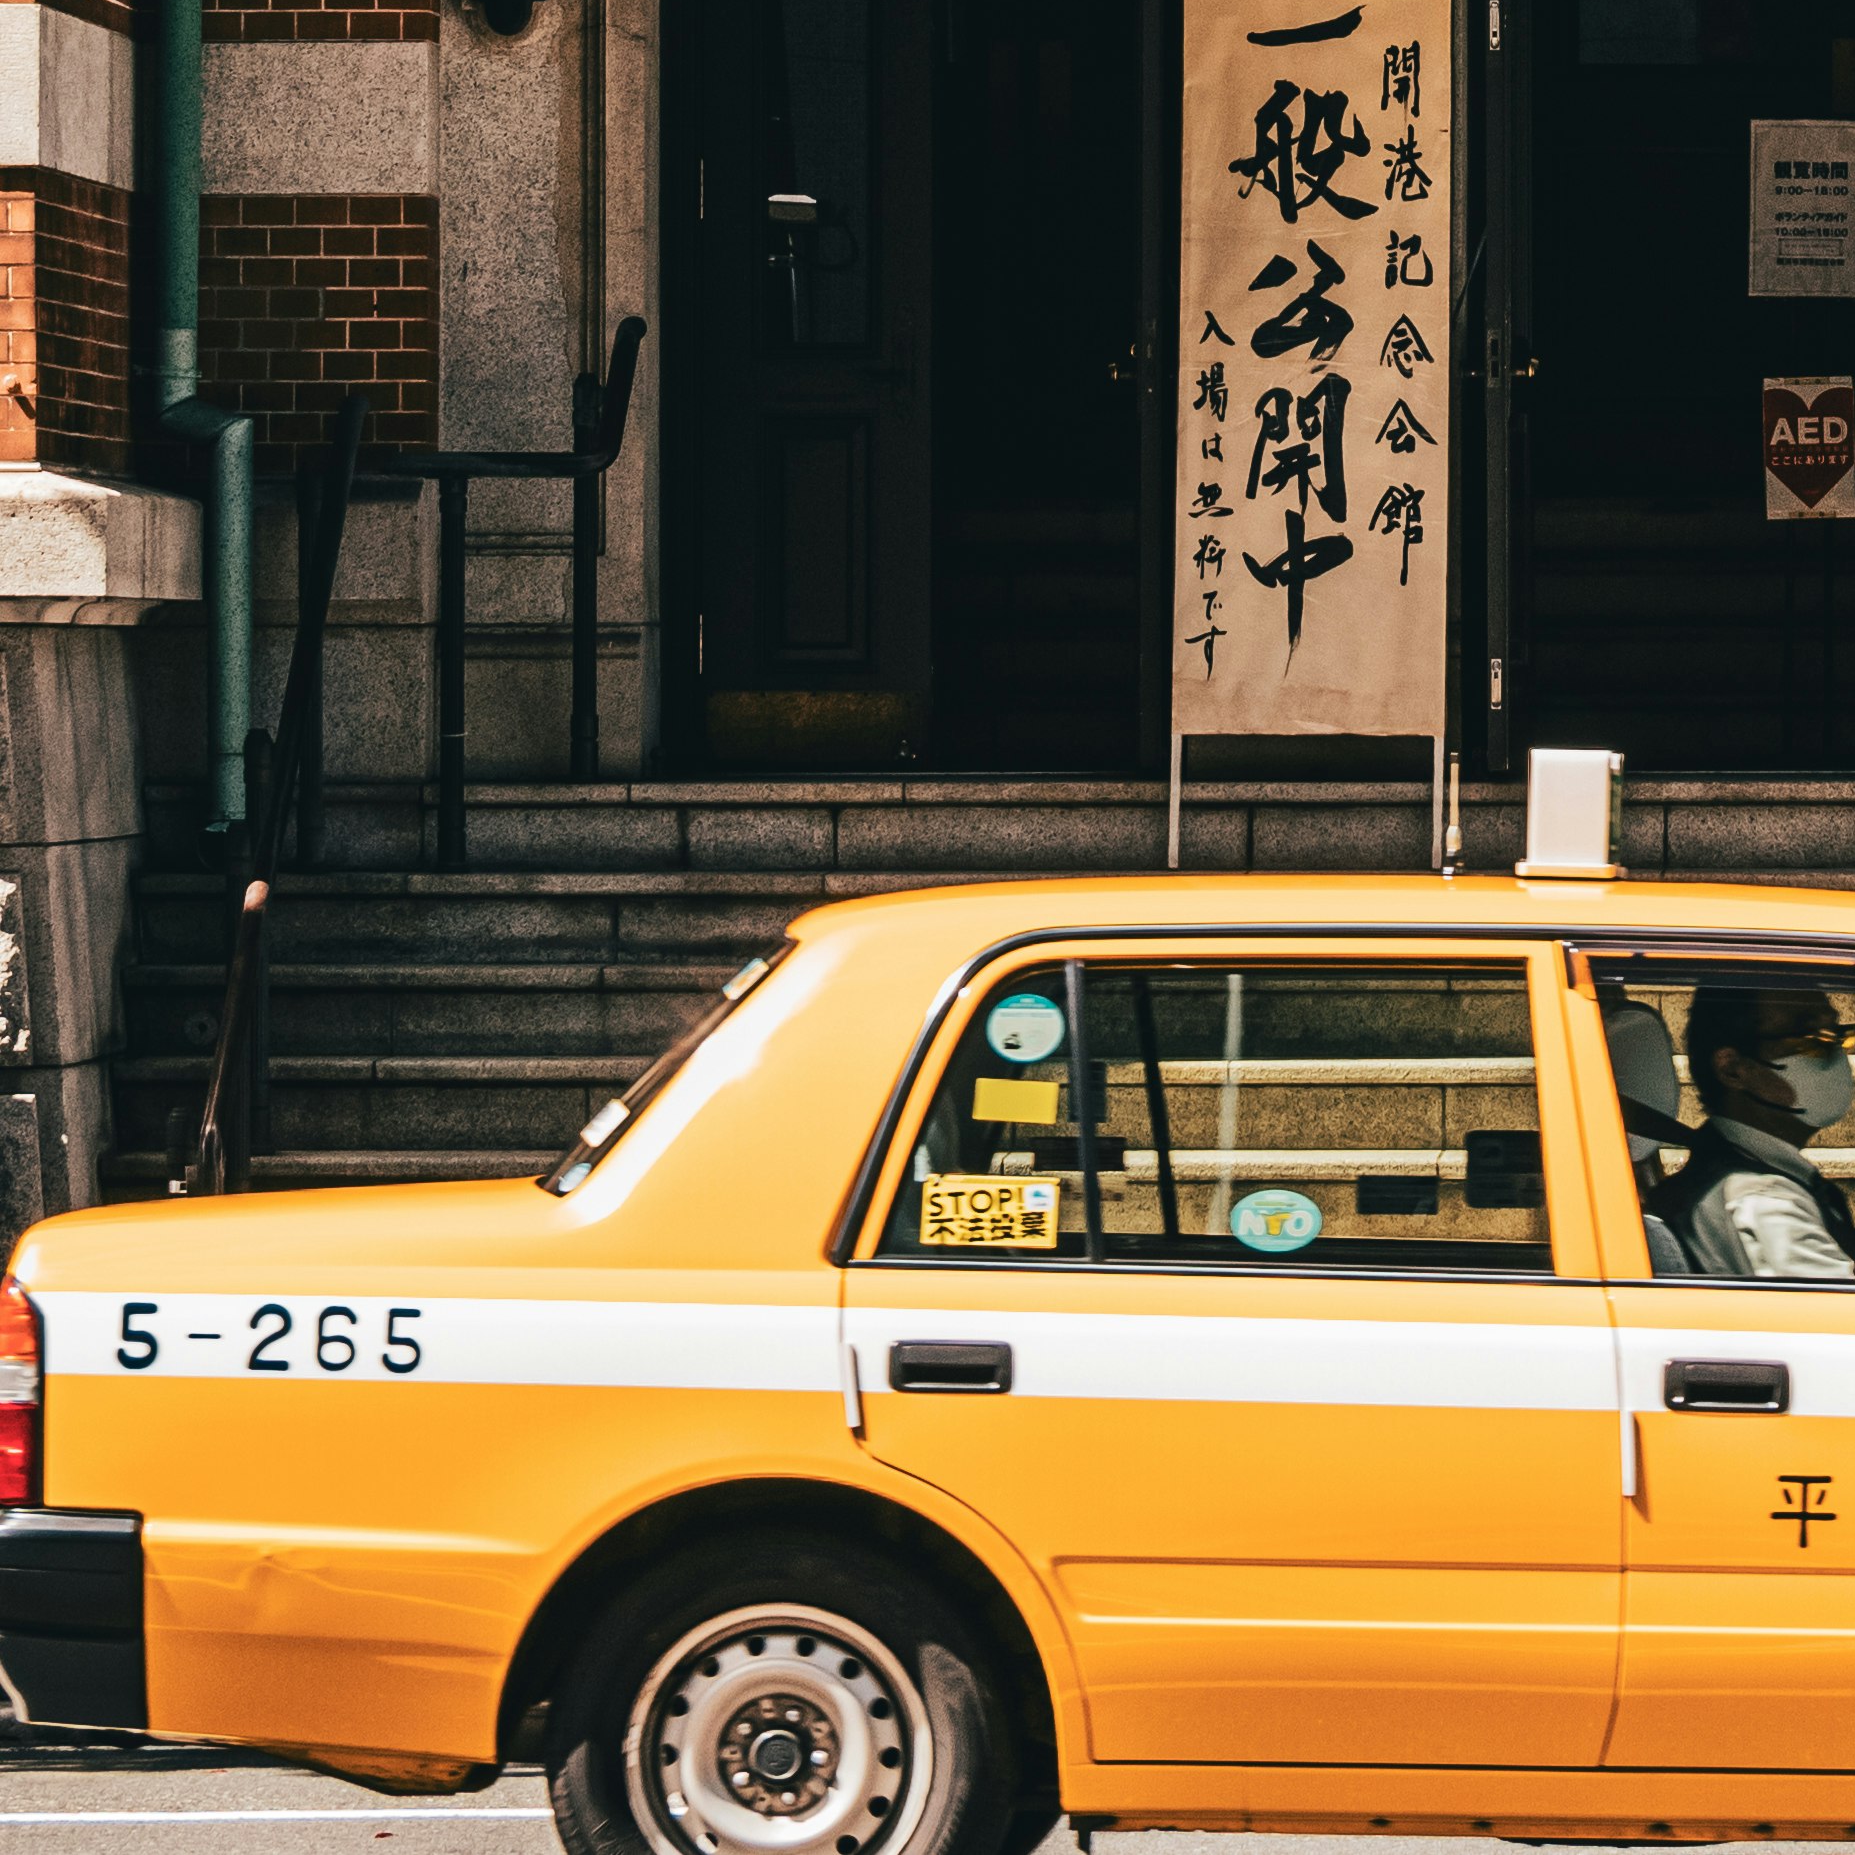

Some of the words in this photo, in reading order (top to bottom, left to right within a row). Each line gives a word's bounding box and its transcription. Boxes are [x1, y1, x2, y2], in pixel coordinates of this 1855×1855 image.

[1227, 4, 1380, 678] 一般公開中
[1368, 39, 1438, 586] 開港記念会館
[1184, 310, 1235, 681] 入場は無料です
[1769, 416, 1848, 446] AED
[1771, 454, 1849, 466] ここにあります
[116, 1302, 422, 1374] 5-265
